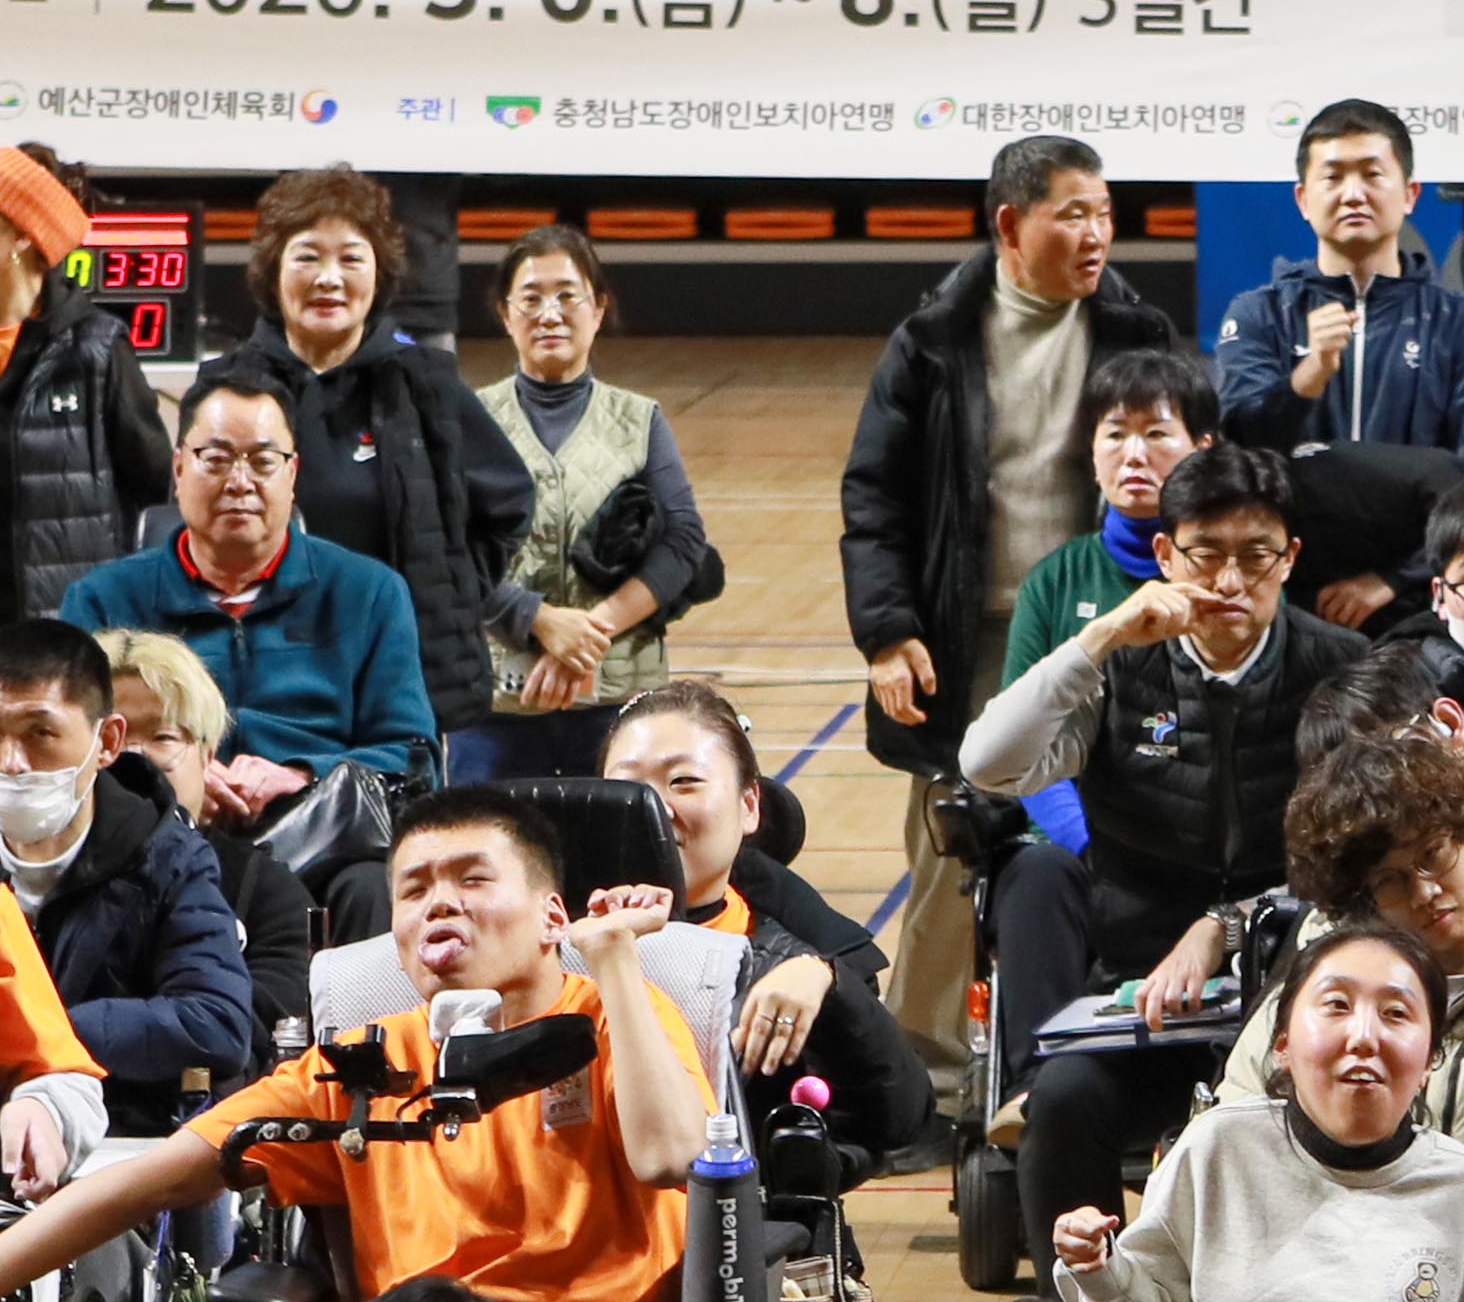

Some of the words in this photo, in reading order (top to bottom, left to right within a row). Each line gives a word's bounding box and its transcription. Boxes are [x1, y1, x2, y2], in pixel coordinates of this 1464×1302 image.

[38, 87, 296, 122] 예산군장애인체육회
[395, 97, 444, 122] 주관
[553, 98, 895, 132] 충청남도장애인보치아연맹
[961, 102, 1246, 134] 대한장애인보치아연맹
